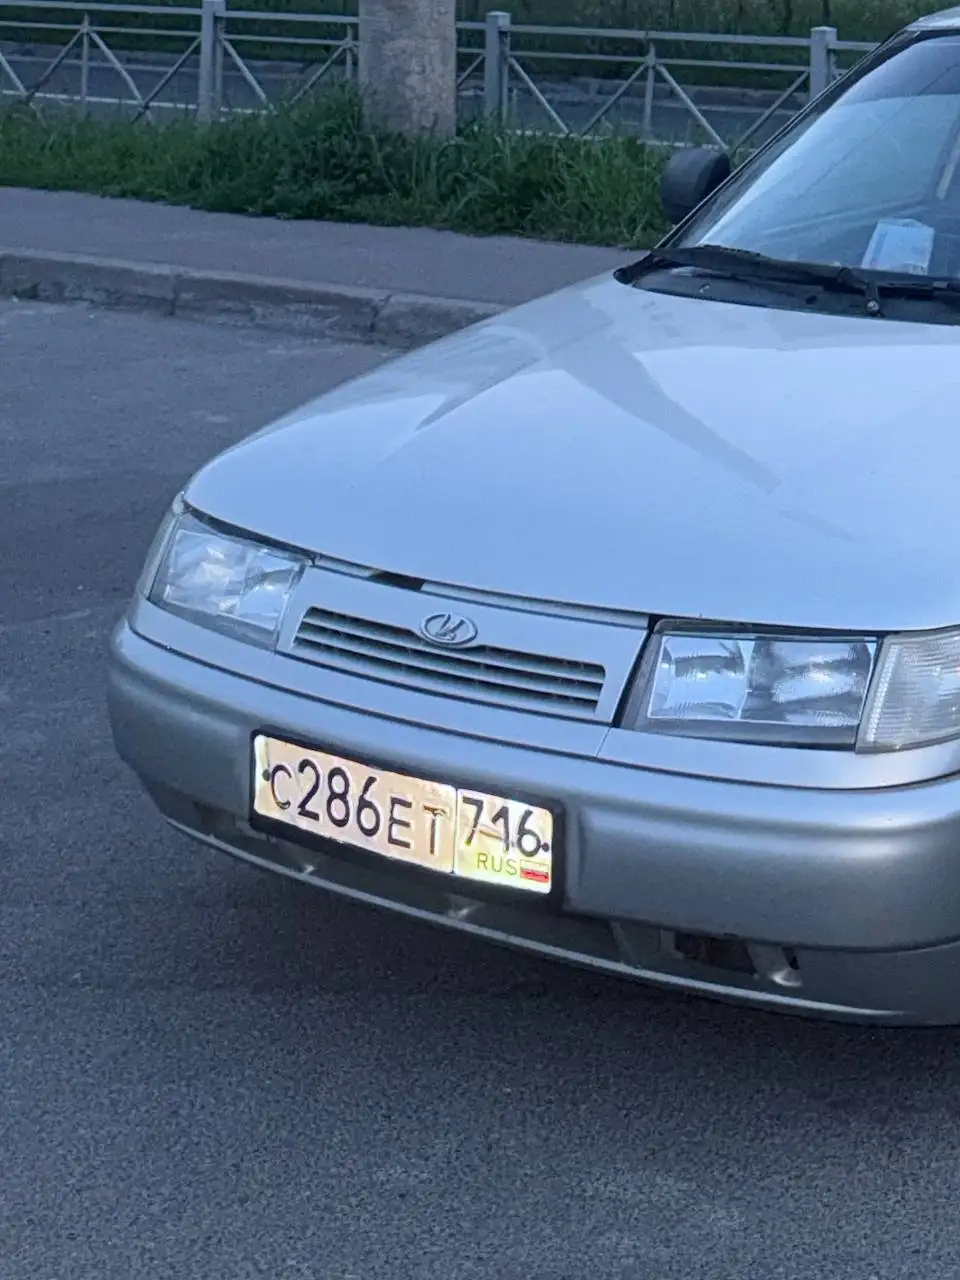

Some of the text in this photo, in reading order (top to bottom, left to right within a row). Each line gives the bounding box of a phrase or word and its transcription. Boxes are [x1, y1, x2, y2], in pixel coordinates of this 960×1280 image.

[270, 758, 543, 858] С286ЕТ 716
[476, 852, 518, 876] RUS
